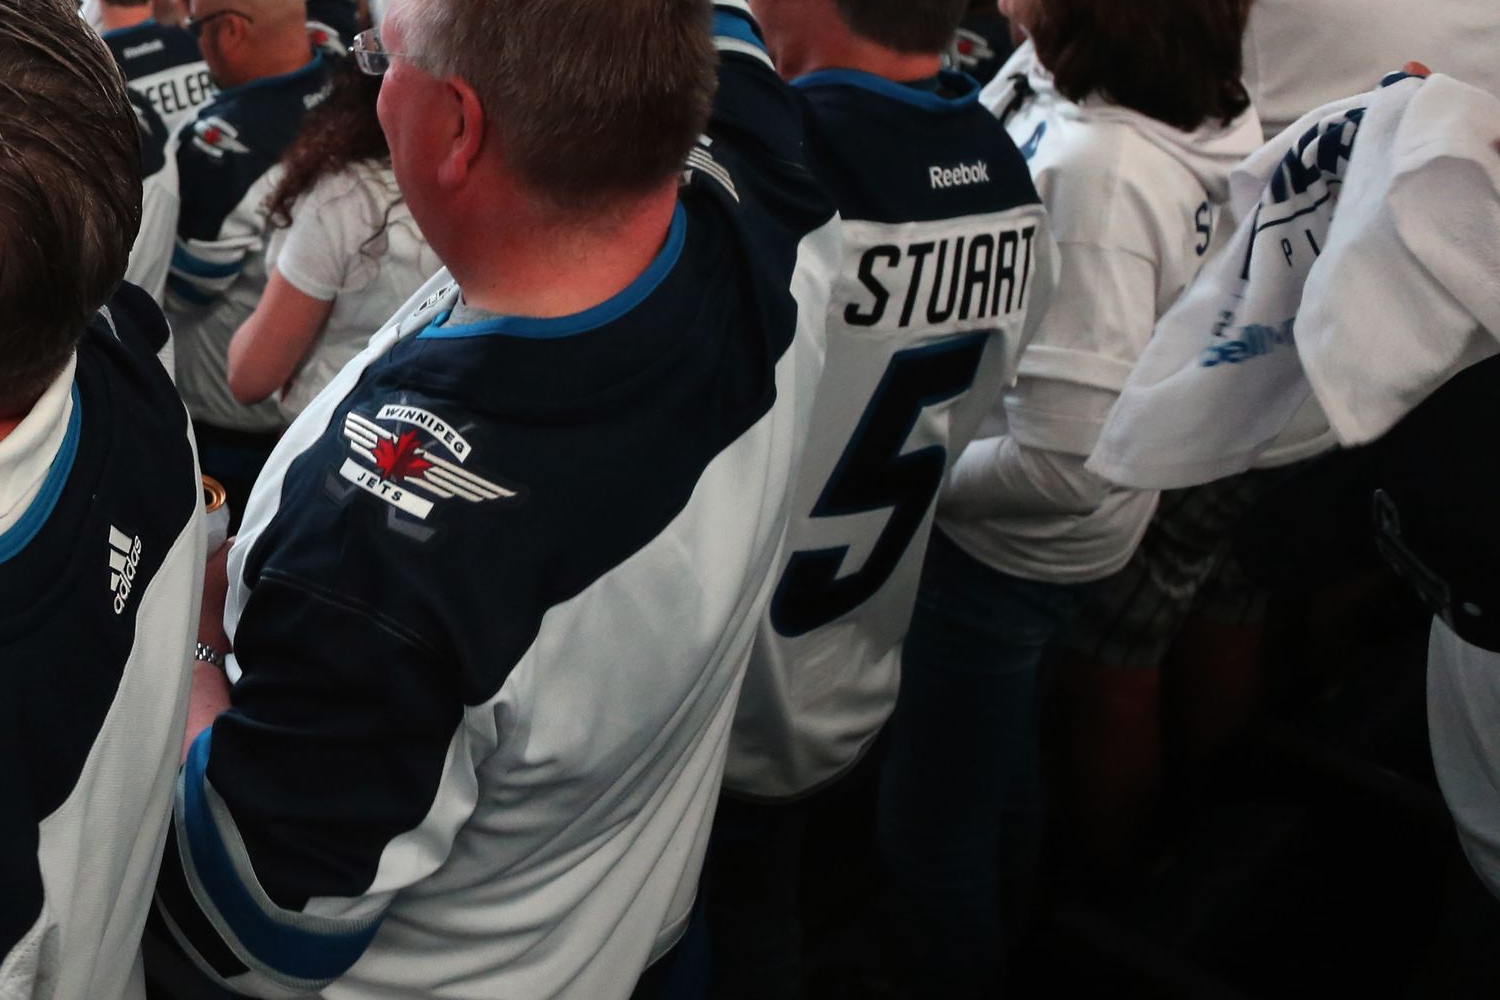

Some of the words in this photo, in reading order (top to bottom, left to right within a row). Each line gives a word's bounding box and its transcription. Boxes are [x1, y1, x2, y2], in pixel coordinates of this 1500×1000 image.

[928, 159, 990, 189] Reebok
[844, 225, 1036, 328] STUART
[385, 406, 465, 454] WINNIPEG
[357, 471, 403, 502] JETS
[769, 328, 989, 638] 5
[113, 535, 142, 614] adidas
